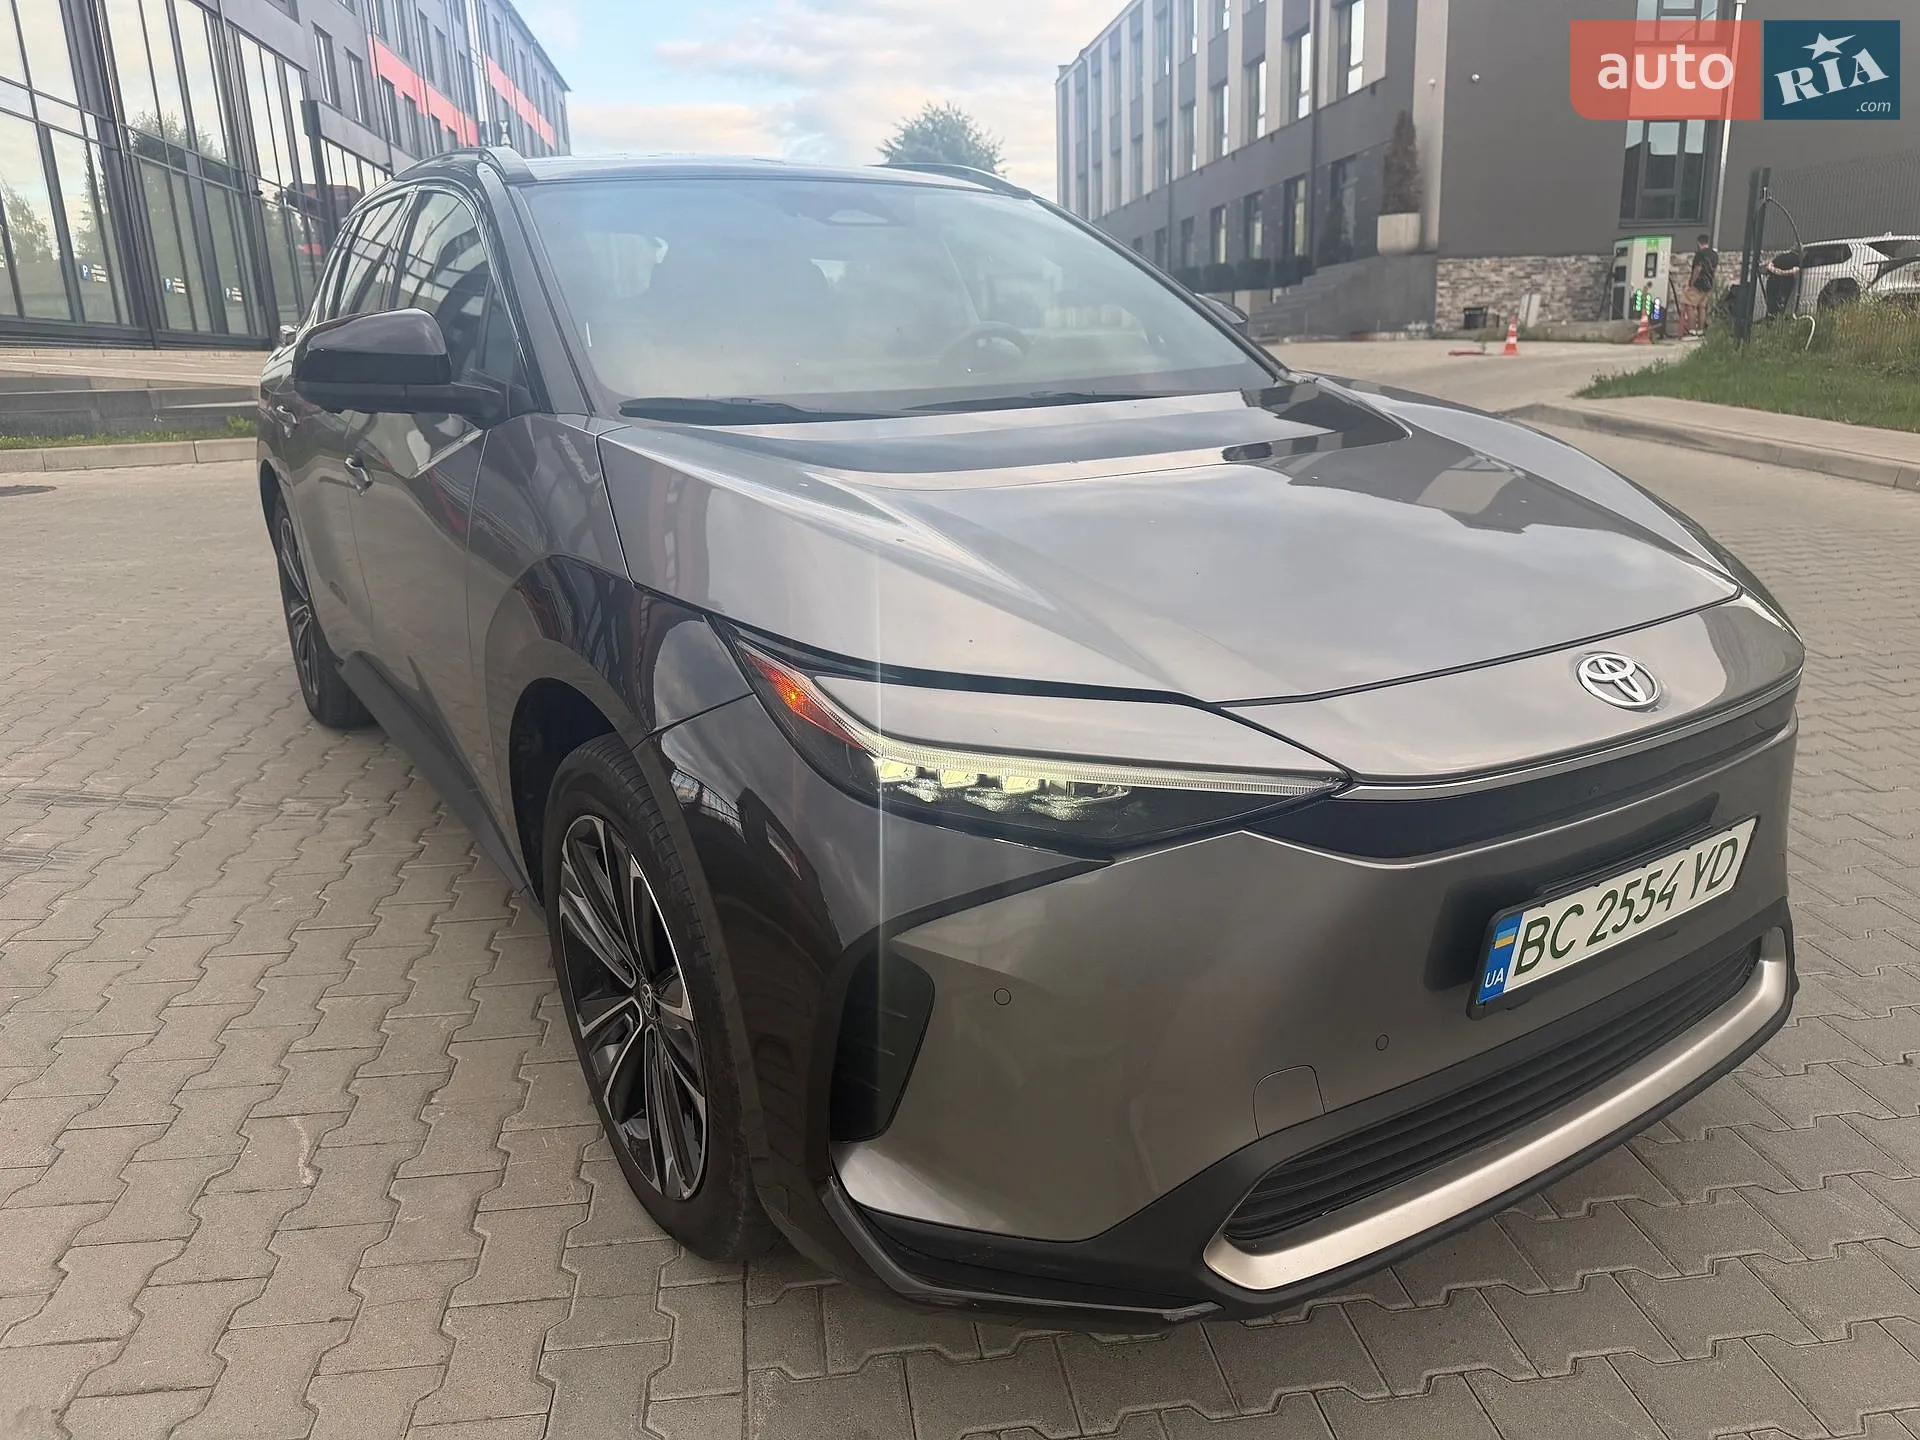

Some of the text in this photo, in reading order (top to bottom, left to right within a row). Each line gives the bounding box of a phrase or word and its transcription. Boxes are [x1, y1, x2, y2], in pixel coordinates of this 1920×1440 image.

[1514, 837, 1738, 976] BC 2554 YD
[1485, 967, 1504, 988] UA
